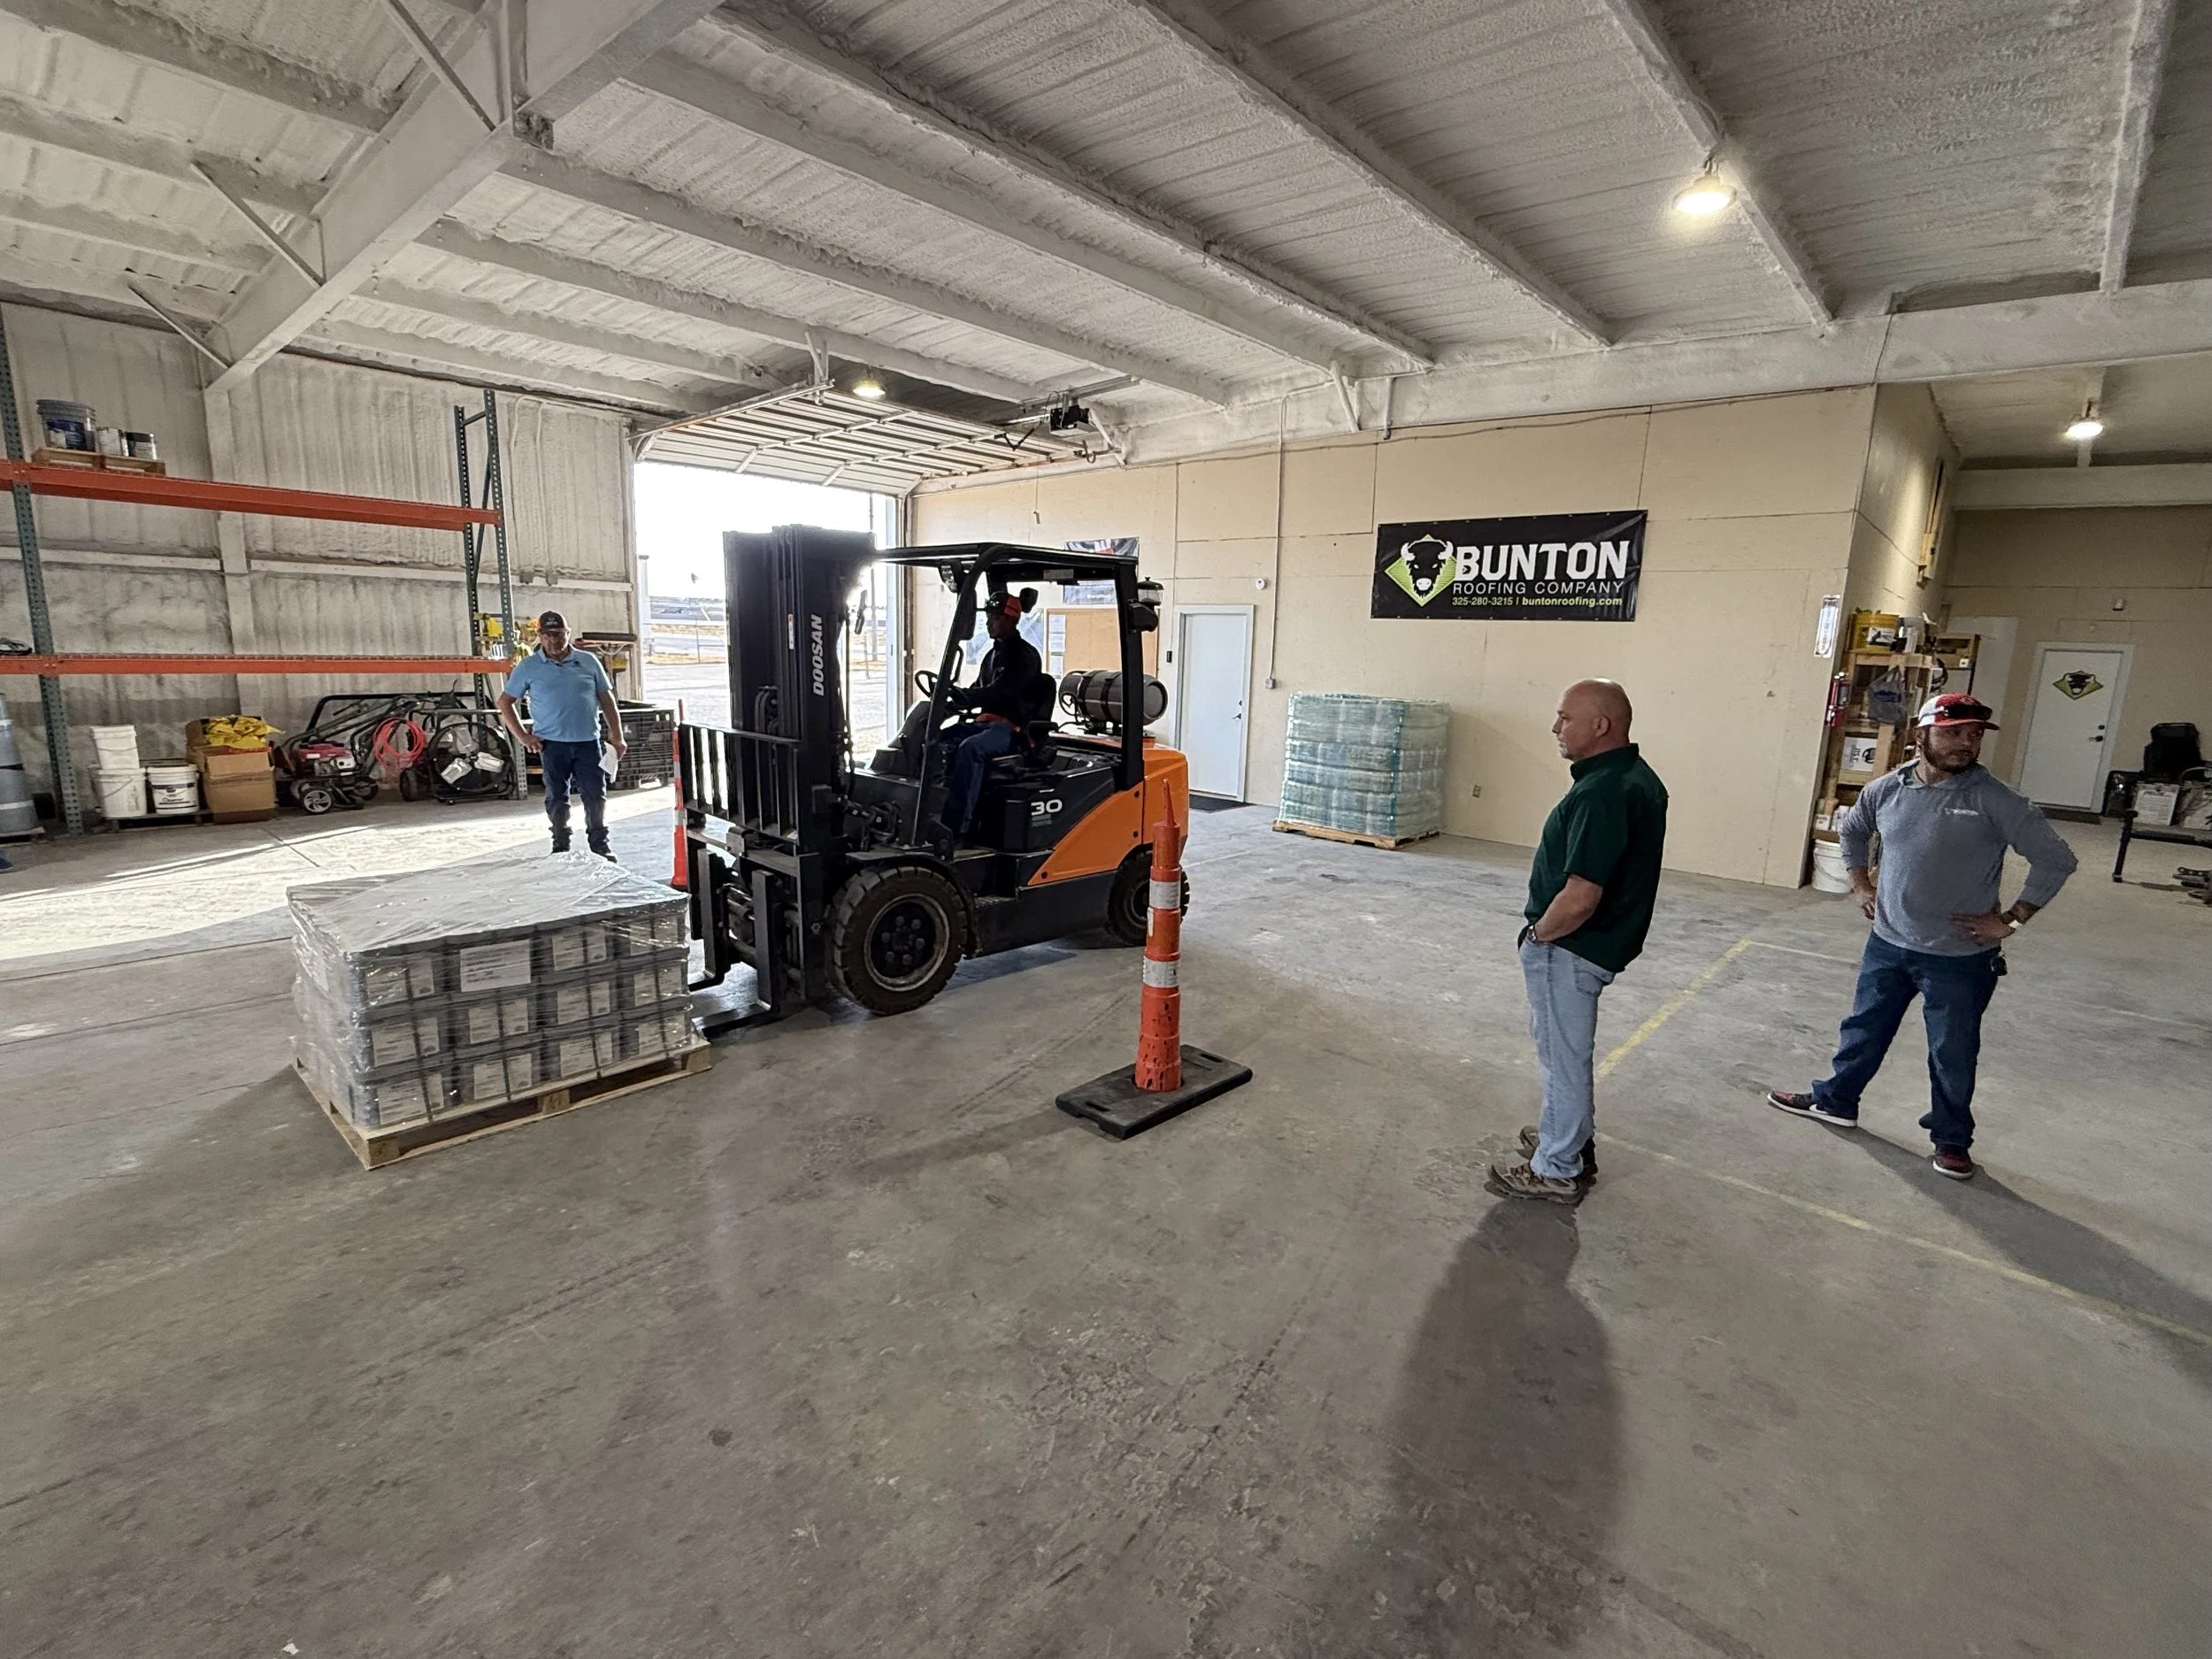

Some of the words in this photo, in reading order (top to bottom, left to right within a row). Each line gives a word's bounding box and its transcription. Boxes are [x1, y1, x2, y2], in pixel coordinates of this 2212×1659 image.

[1455, 541, 1630, 580] BUNTON
[1453, 582, 1525, 595] ROOFING
[1535, 581, 1624, 595] COMPANY
[1522, 596, 1622, 607] buntonroofing.com
[810, 614, 824, 696] DOOSAN
[1031, 799, 1063, 816] 30
